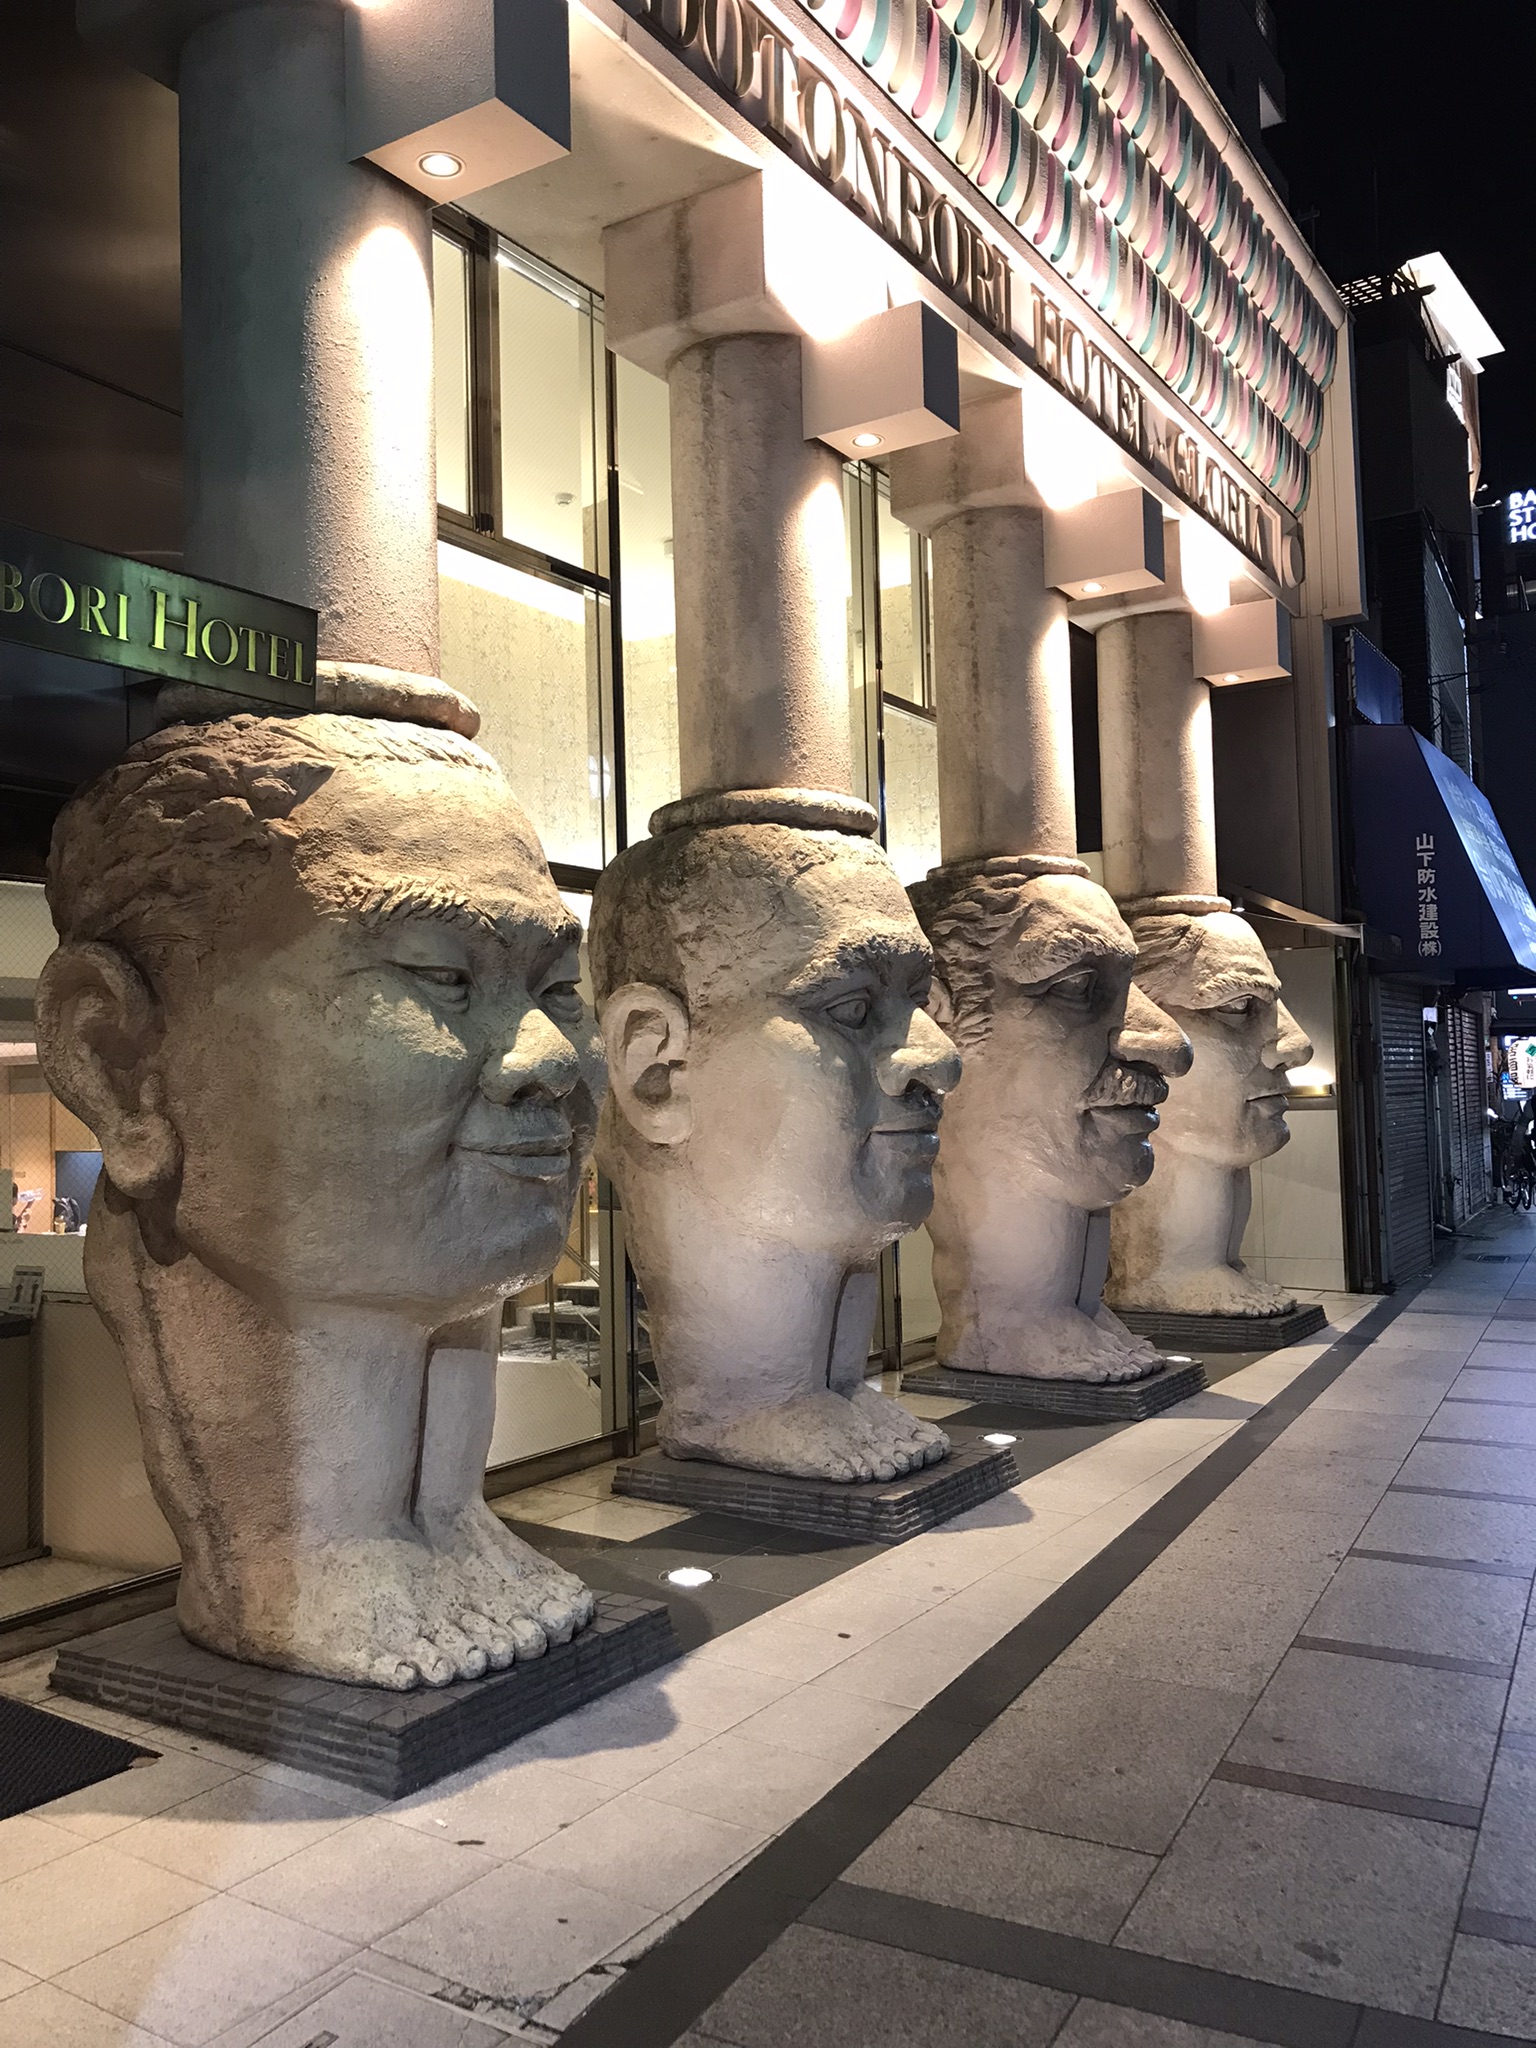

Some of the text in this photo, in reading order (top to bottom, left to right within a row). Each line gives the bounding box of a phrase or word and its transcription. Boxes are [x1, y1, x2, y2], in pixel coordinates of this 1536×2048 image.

[1031, 282, 1155, 470] HOTEL
[1164, 416, 1268, 571] GLORIA
[0, 561, 313, 686] BORI HOTEL
